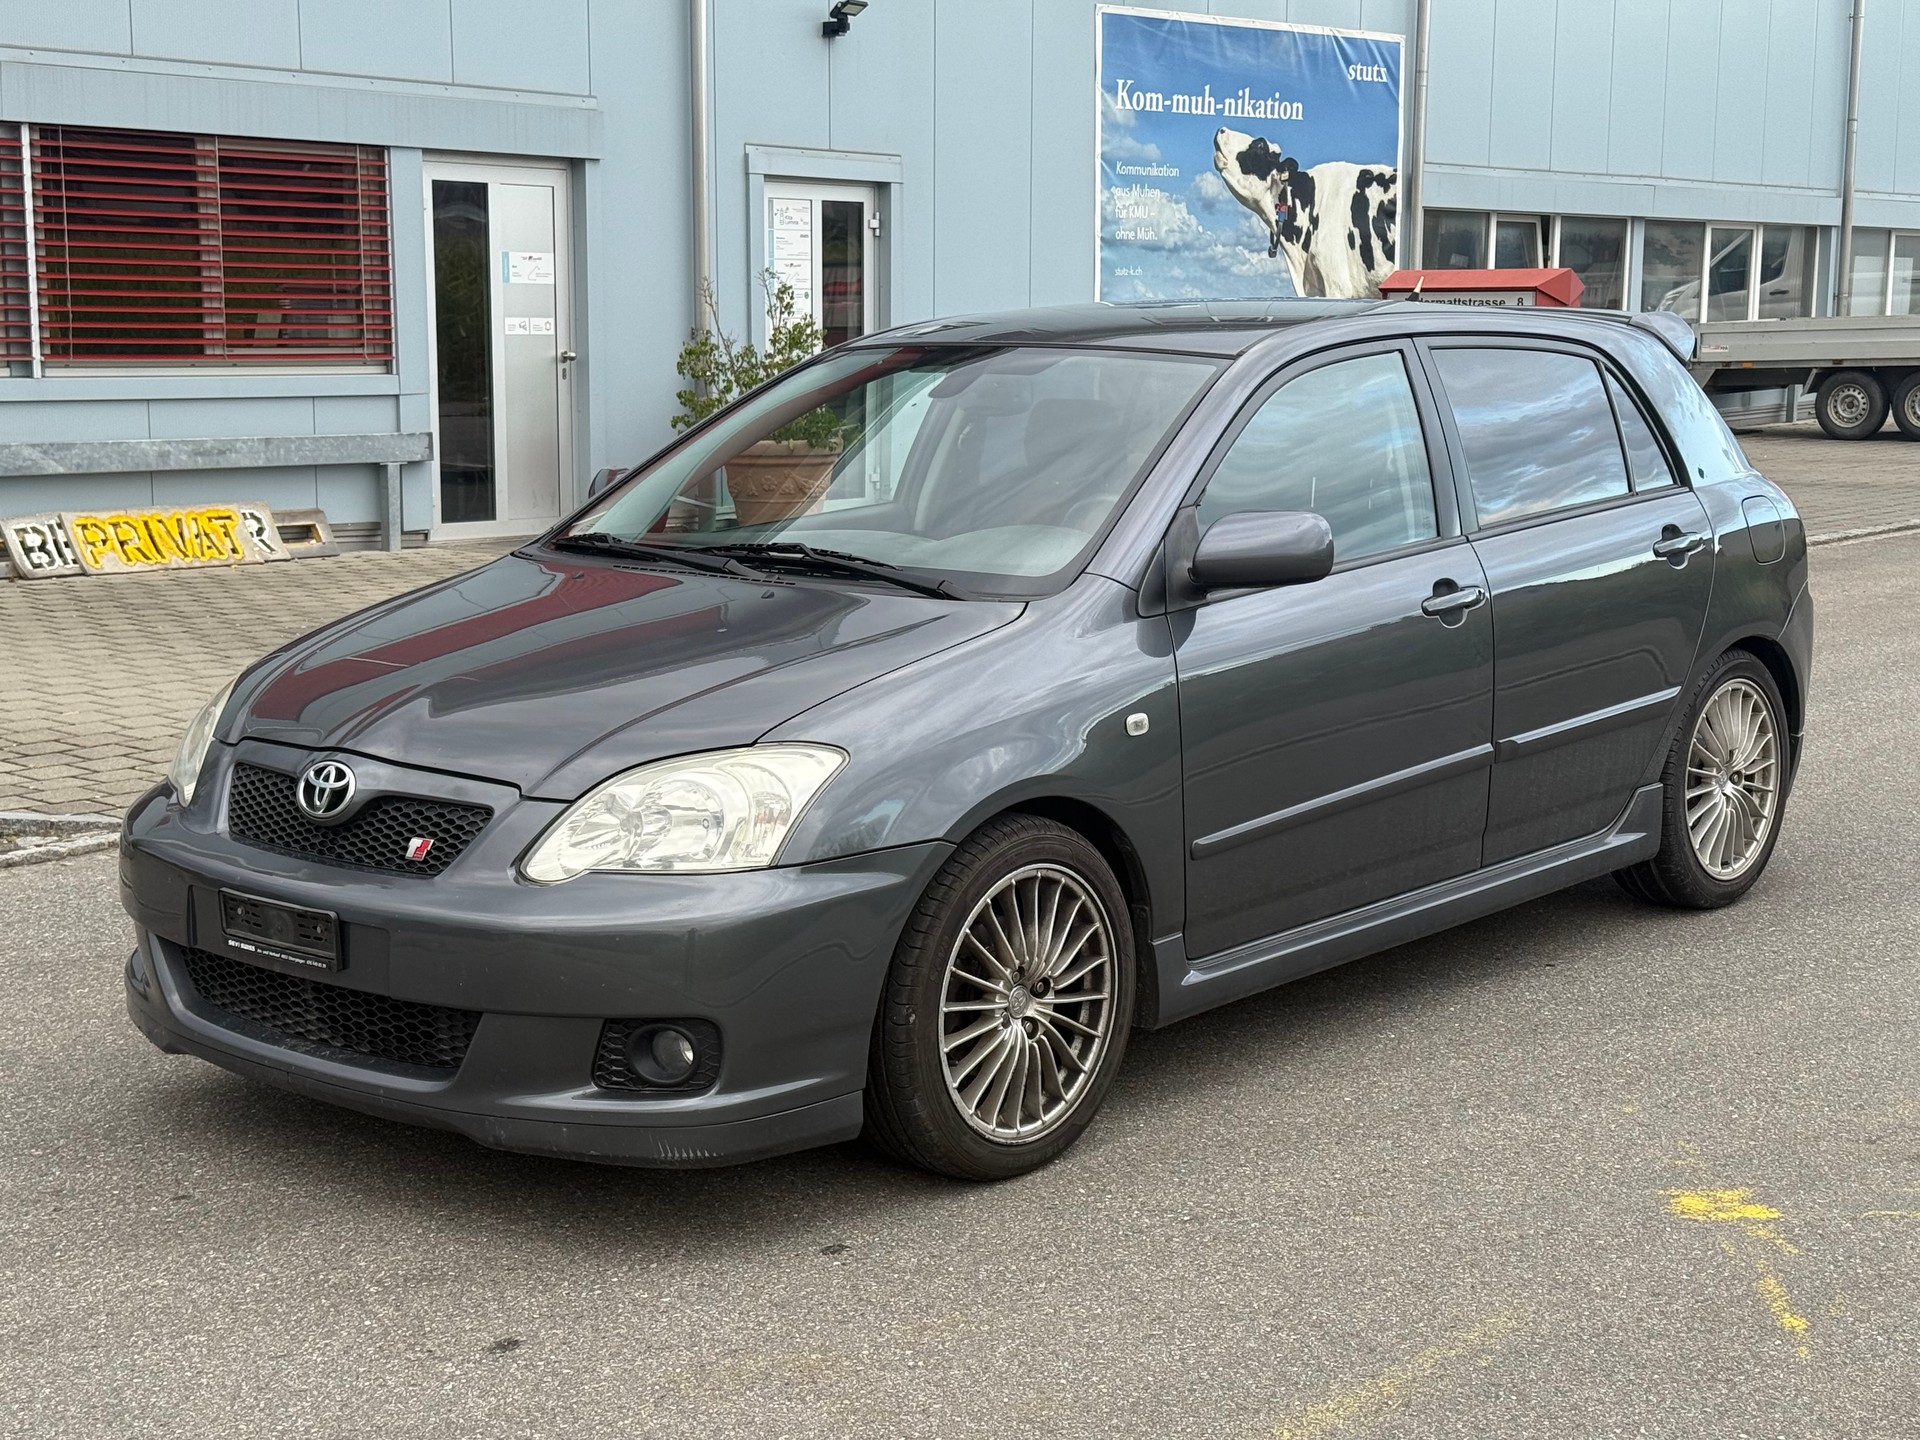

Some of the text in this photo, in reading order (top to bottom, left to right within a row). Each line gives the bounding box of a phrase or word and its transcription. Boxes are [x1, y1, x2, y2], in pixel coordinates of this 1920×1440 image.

[1115, 78, 1304, 121] Kom-muh-nikation
[1115, 161, 1180, 177] Kommunikation
[1115, 184, 1160, 198] aus Muhen
[1115, 205, 1127, 218] für
[1129, 206, 1148, 218] KMU
[1115, 226, 1158, 240] ohne Müh.
[1114, 265, 1143, 276] stutz-k.ch
[1516, 297, 1524, 306] 8
[73, 509, 243, 568] PRIVAT
